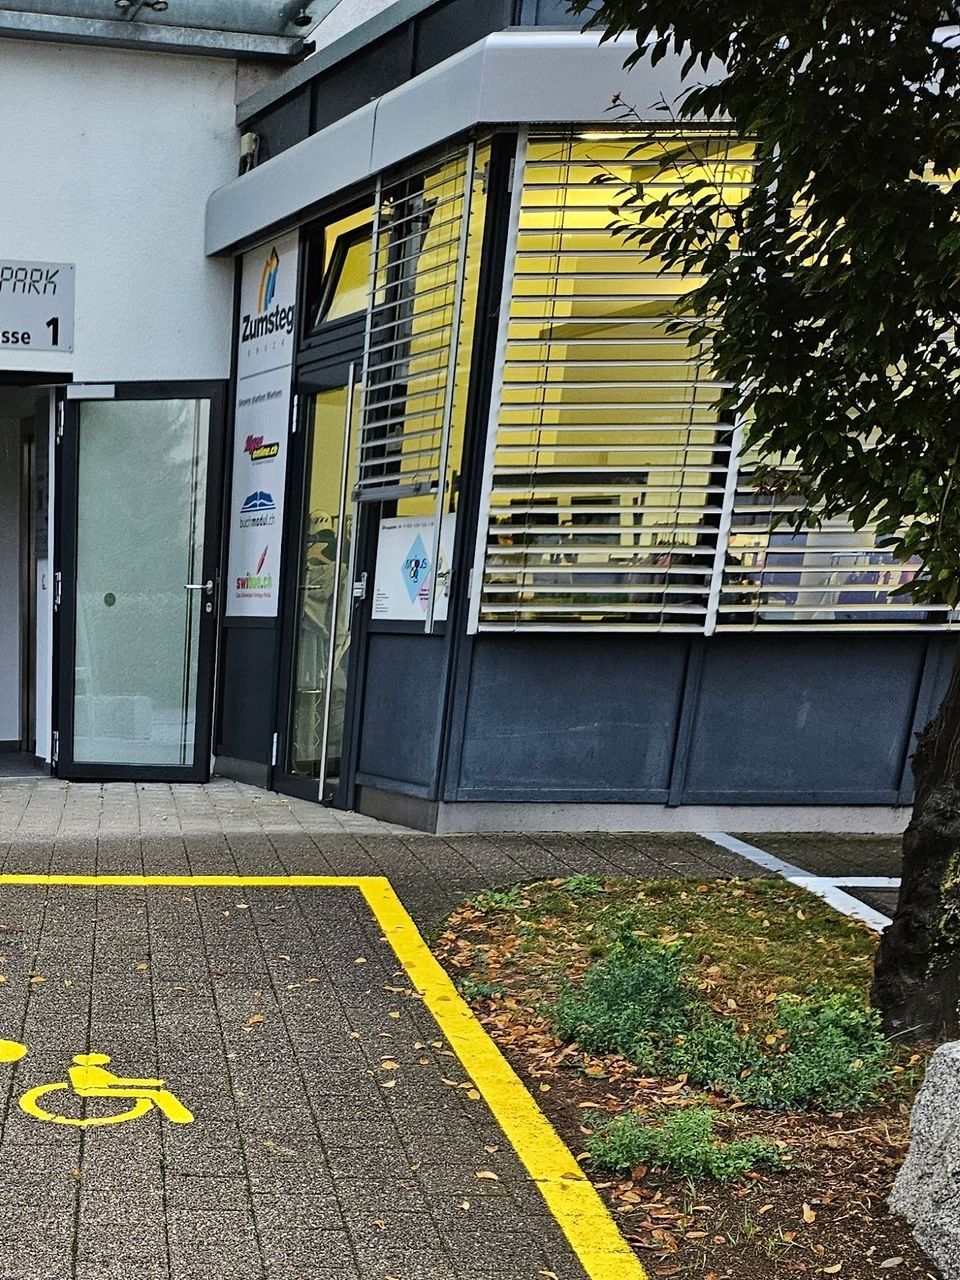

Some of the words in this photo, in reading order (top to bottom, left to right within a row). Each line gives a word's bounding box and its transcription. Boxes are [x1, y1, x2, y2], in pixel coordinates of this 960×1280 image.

[0, 266, 59, 295] PARK
[45, 317, 59, 346] 1
[241, 304, 296, 344] Zumsteg
